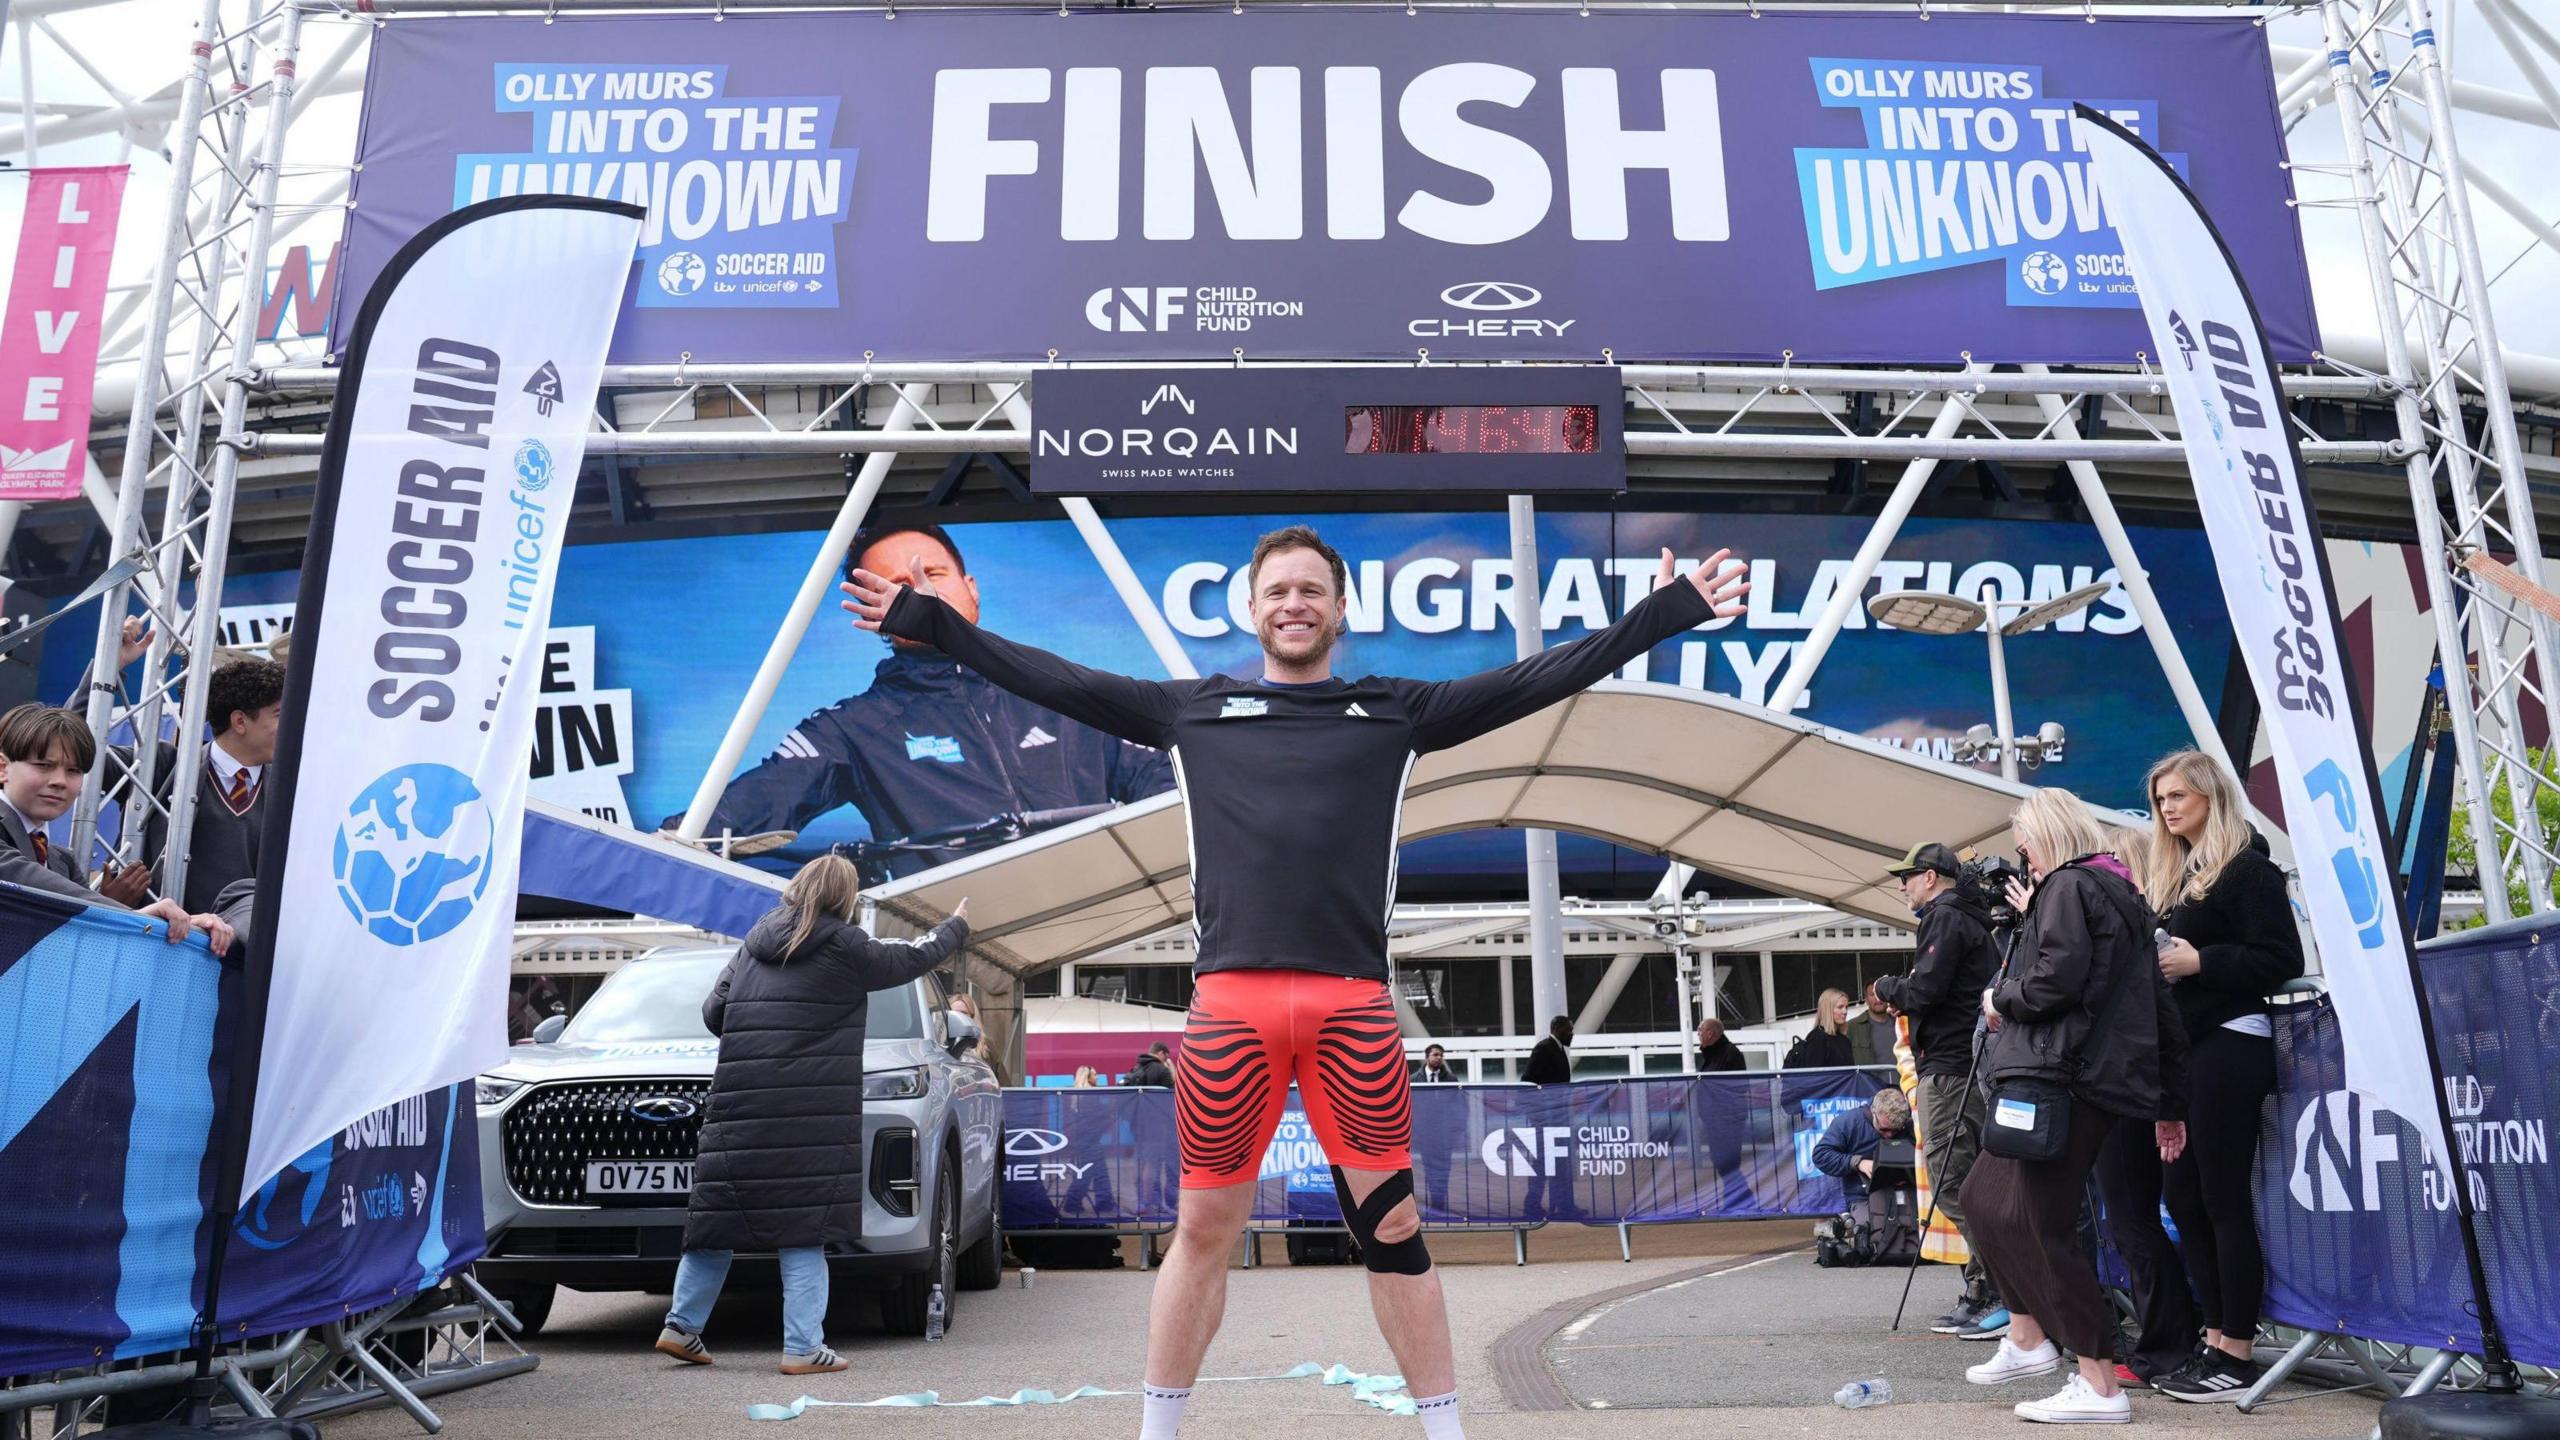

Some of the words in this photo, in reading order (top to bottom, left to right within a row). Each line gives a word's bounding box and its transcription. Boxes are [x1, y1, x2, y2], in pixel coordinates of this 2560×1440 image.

[505, 73, 596, 102] OLLY
[603, 71, 714, 101] MURS
[1826, 68, 1914, 98] OLLY
[1924, 70, 2033, 100] MURS
[547, 108, 688, 154] INTO
[705, 106, 819, 151] THE
[1879, 107, 2019, 152] INTO
[926, 62, 1731, 245] FINISH
[470, 159, 842, 248] NOWN
[1814, 158, 2119, 276] UNKNOW
[715, 253, 788, 276] SOCCER
[792, 252, 826, 275] AID
[23, 182, 90, 421] LIVE
[713, 281, 737, 293] itv
[742, 280, 783, 293] unicef
[1196, 286, 1257, 302] CHILD
[2078, 282, 2100, 293] itv
[2106, 281, 2140, 294] unice
[1085, 287, 1188, 332] CNF
[1196, 301, 1304, 317] NUTRITION
[1196, 316, 1252, 332] FUND
[1408, 318, 1576, 337] CHERY
[407, 337, 501, 450] AID
[1038, 427, 1298, 458] NORQAIN
[1102, 469, 1136, 478] SWISS
[1141, 469, 1173, 478] MADE
[1178, 468, 1235, 477] WATCHES
[366, 459, 486, 722] SOCCER
[1162, 557, 2150, 638] CNGRATLATIONS
[396, 1093, 427, 1146] AID
[1806, 1100, 1834, 1114] OLLY
[1578, 1126, 1630, 1142] CHILD
[1481, 1126, 1571, 1177] CNF
[1579, 1141, 1669, 1159] NUTRITION
[600, 1166, 666, 1190] OV75
[673, 1166, 697, 1190] N
[1579, 1160, 1626, 1176] FUND
